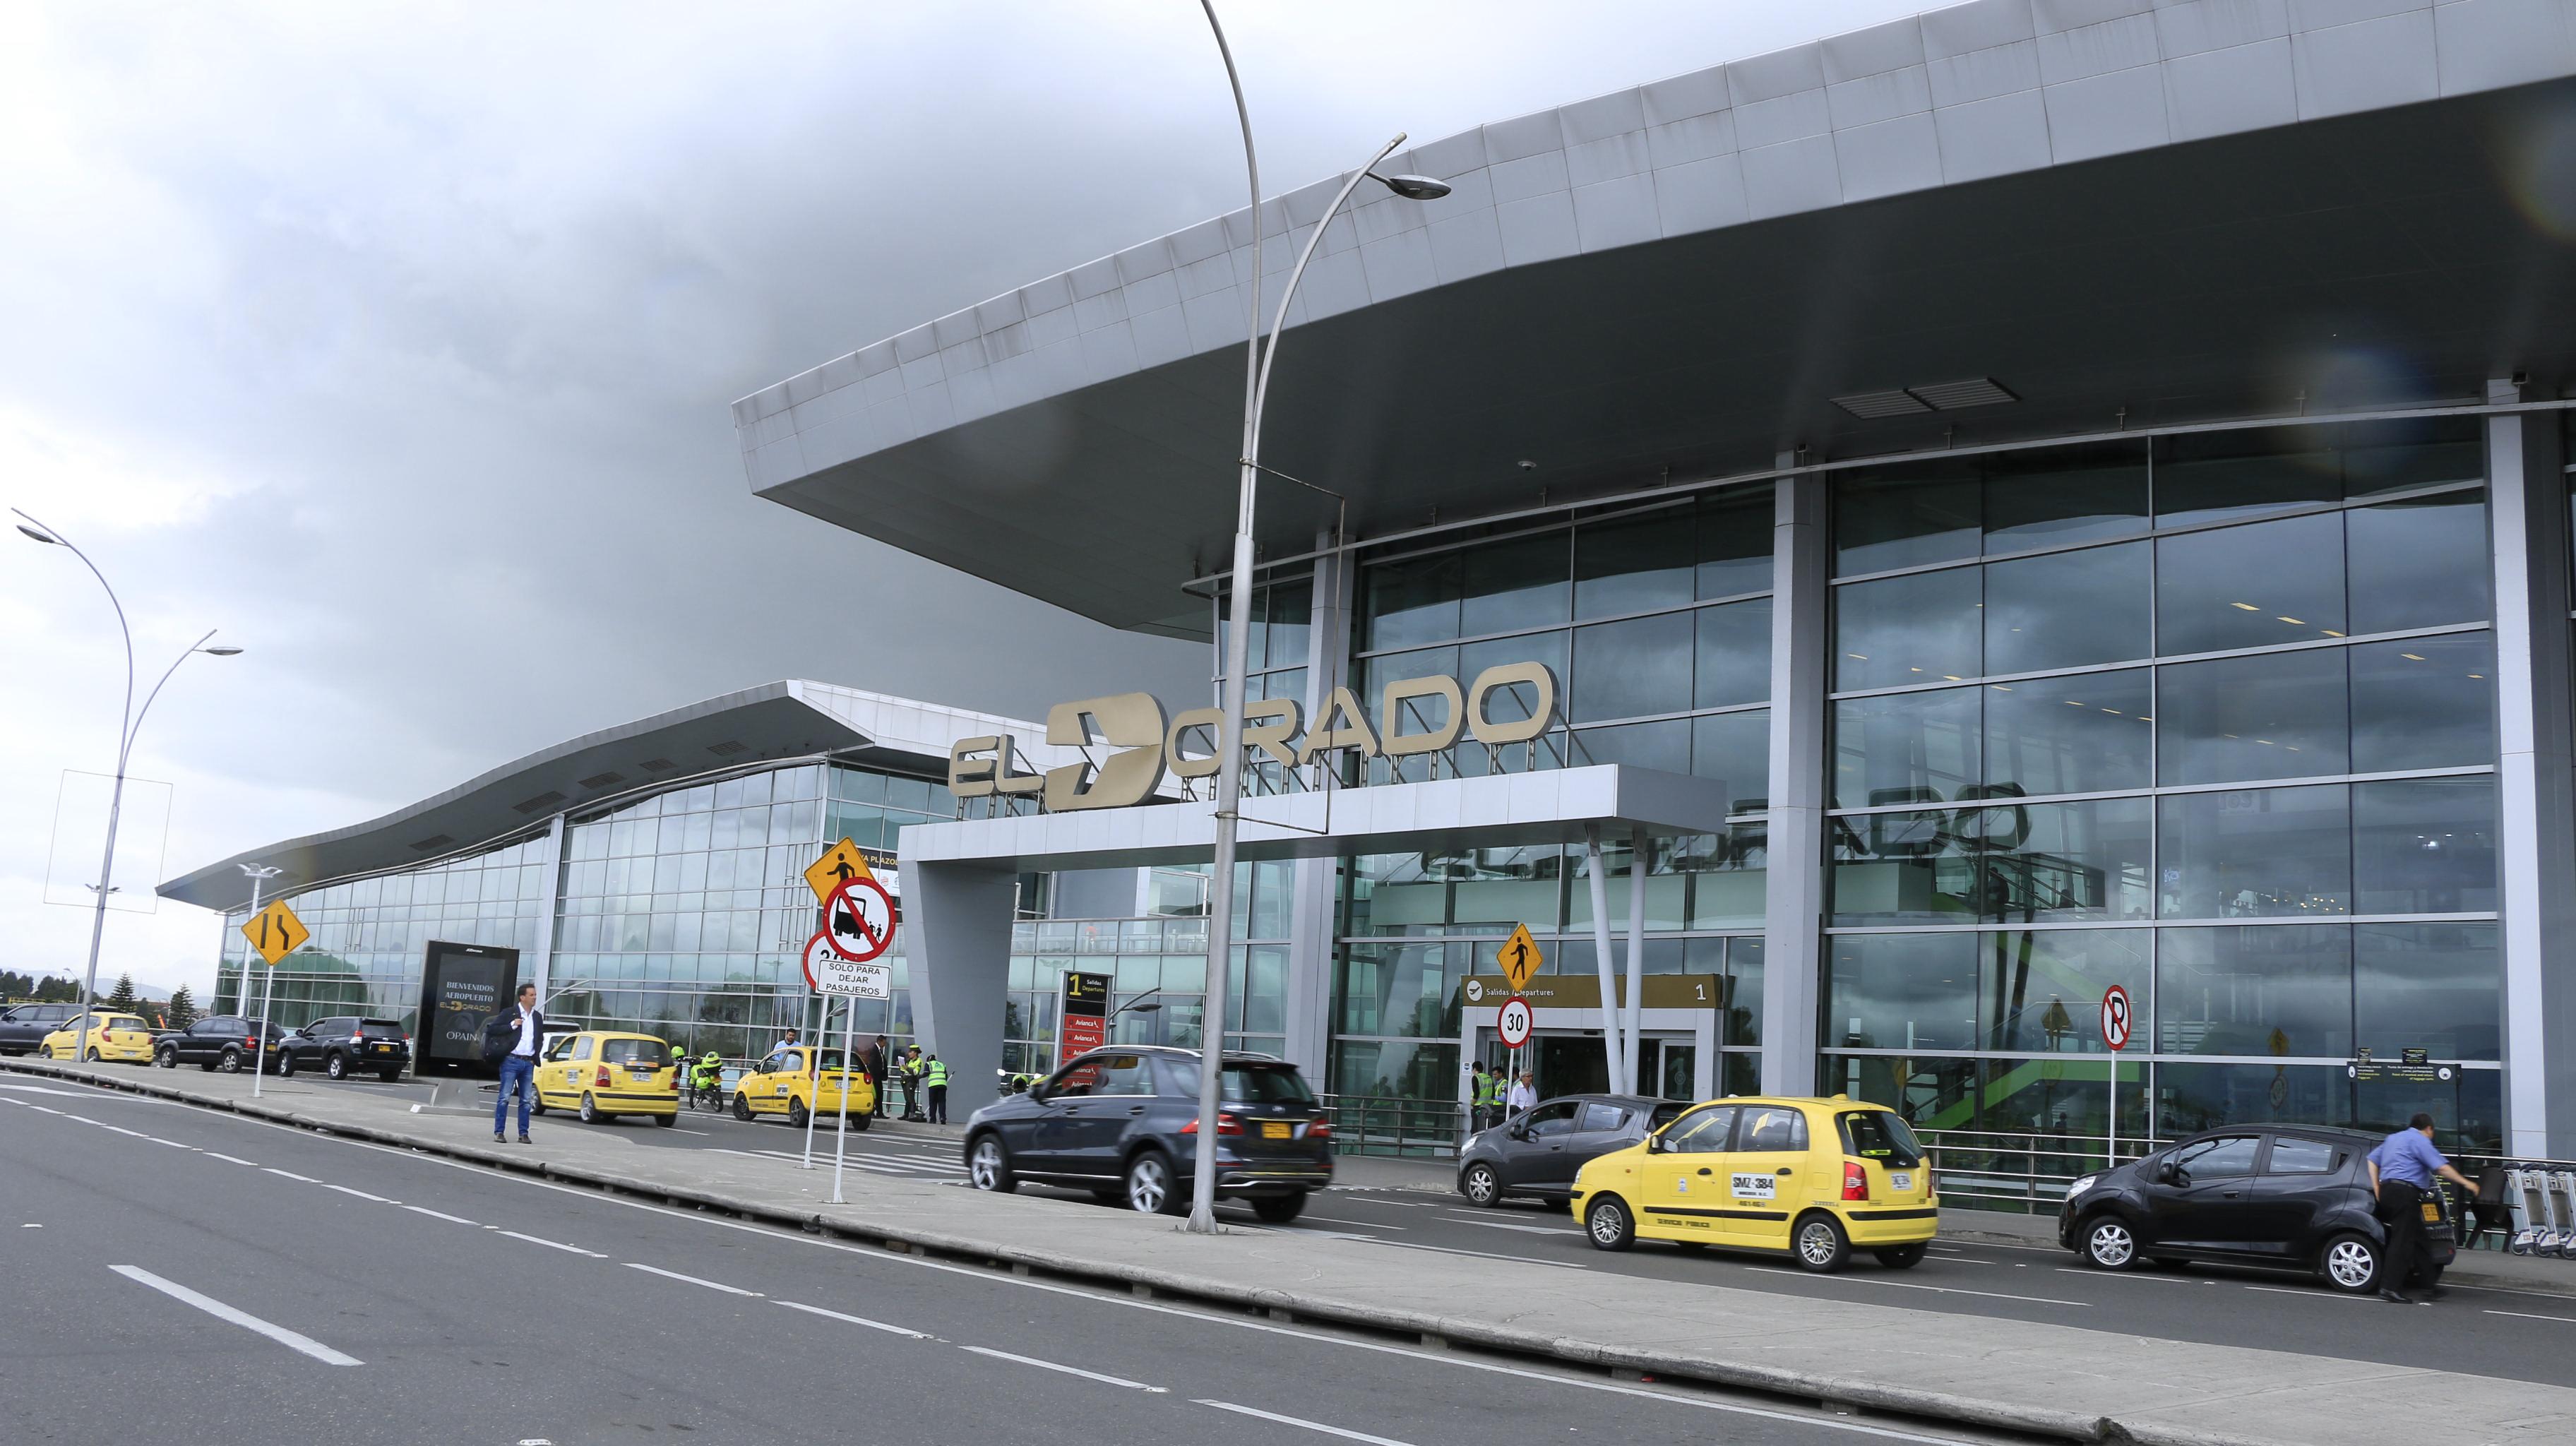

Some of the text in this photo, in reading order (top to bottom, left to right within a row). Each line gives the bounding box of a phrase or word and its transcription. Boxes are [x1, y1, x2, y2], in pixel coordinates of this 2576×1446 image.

[949, 734, 1045, 797] EL
[828, 963, 881, 975] SOLO PARA
[838, 974, 869, 984] DEJAR
[1069, 974, 1082, 996] 1
[446, 981, 494, 992] BIENVENIDOS
[825, 983, 880, 996] PASAJEROS
[1486, 988, 1510, 996] Salidas
[1695, 984, 1707, 1000] 1
[445, 991, 494, 1003] AEROPUERTO
[1507, 1013, 1524, 1032] 30
